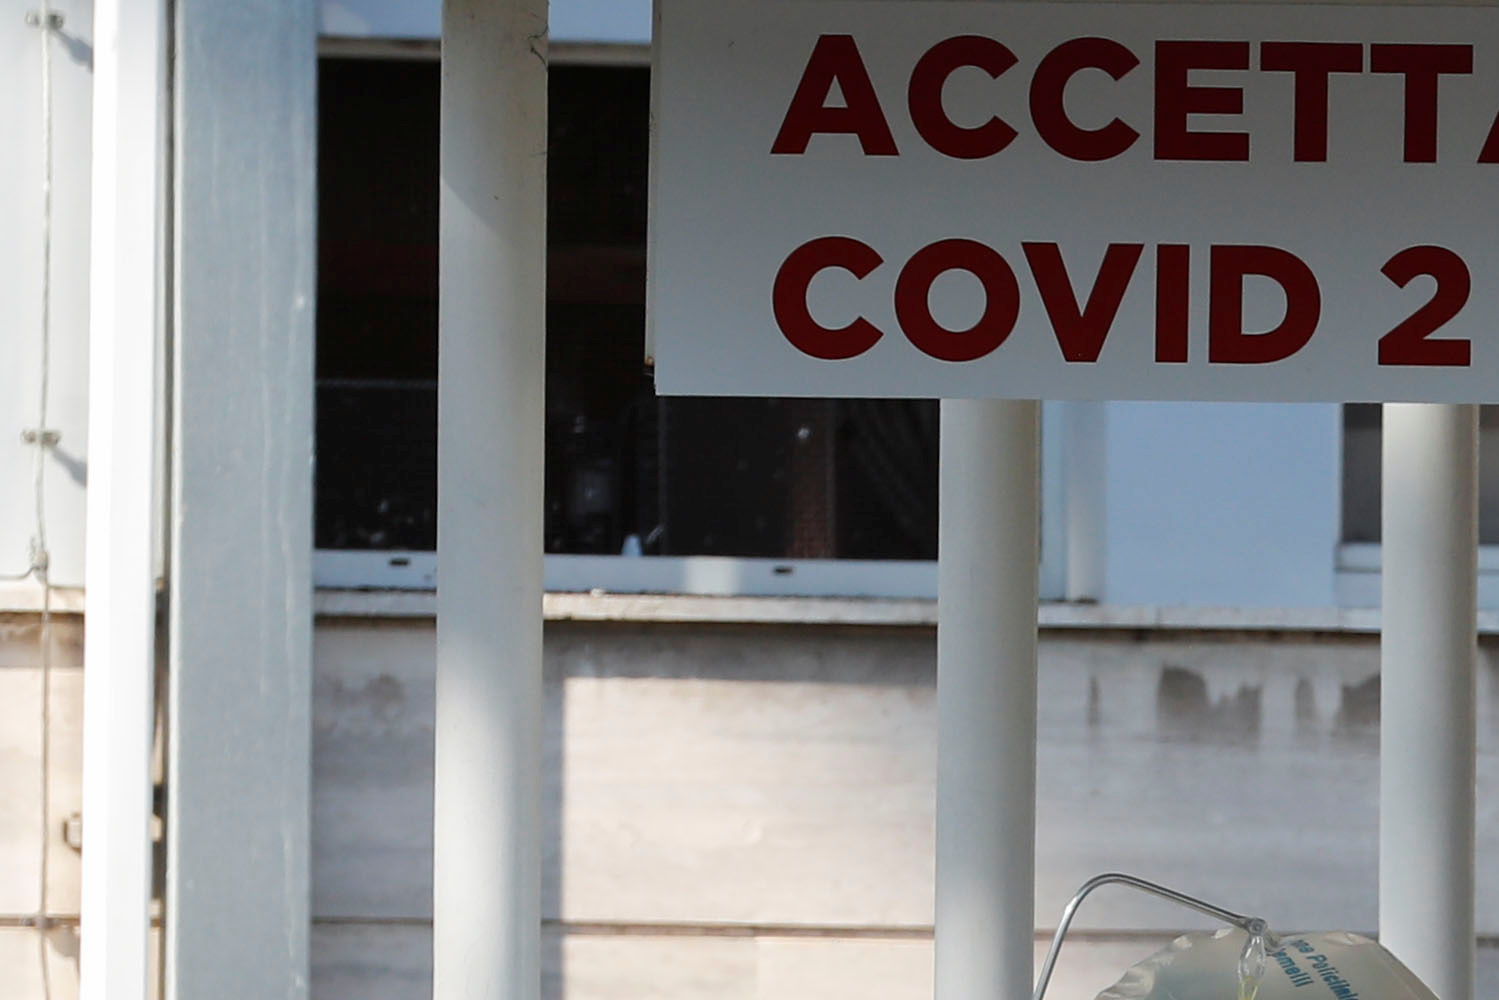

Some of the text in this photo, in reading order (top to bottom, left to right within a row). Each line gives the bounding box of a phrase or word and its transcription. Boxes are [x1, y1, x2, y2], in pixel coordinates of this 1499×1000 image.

[772, 235, 1471, 367] COVID 2
[1271, 950, 1314, 988] emelli
